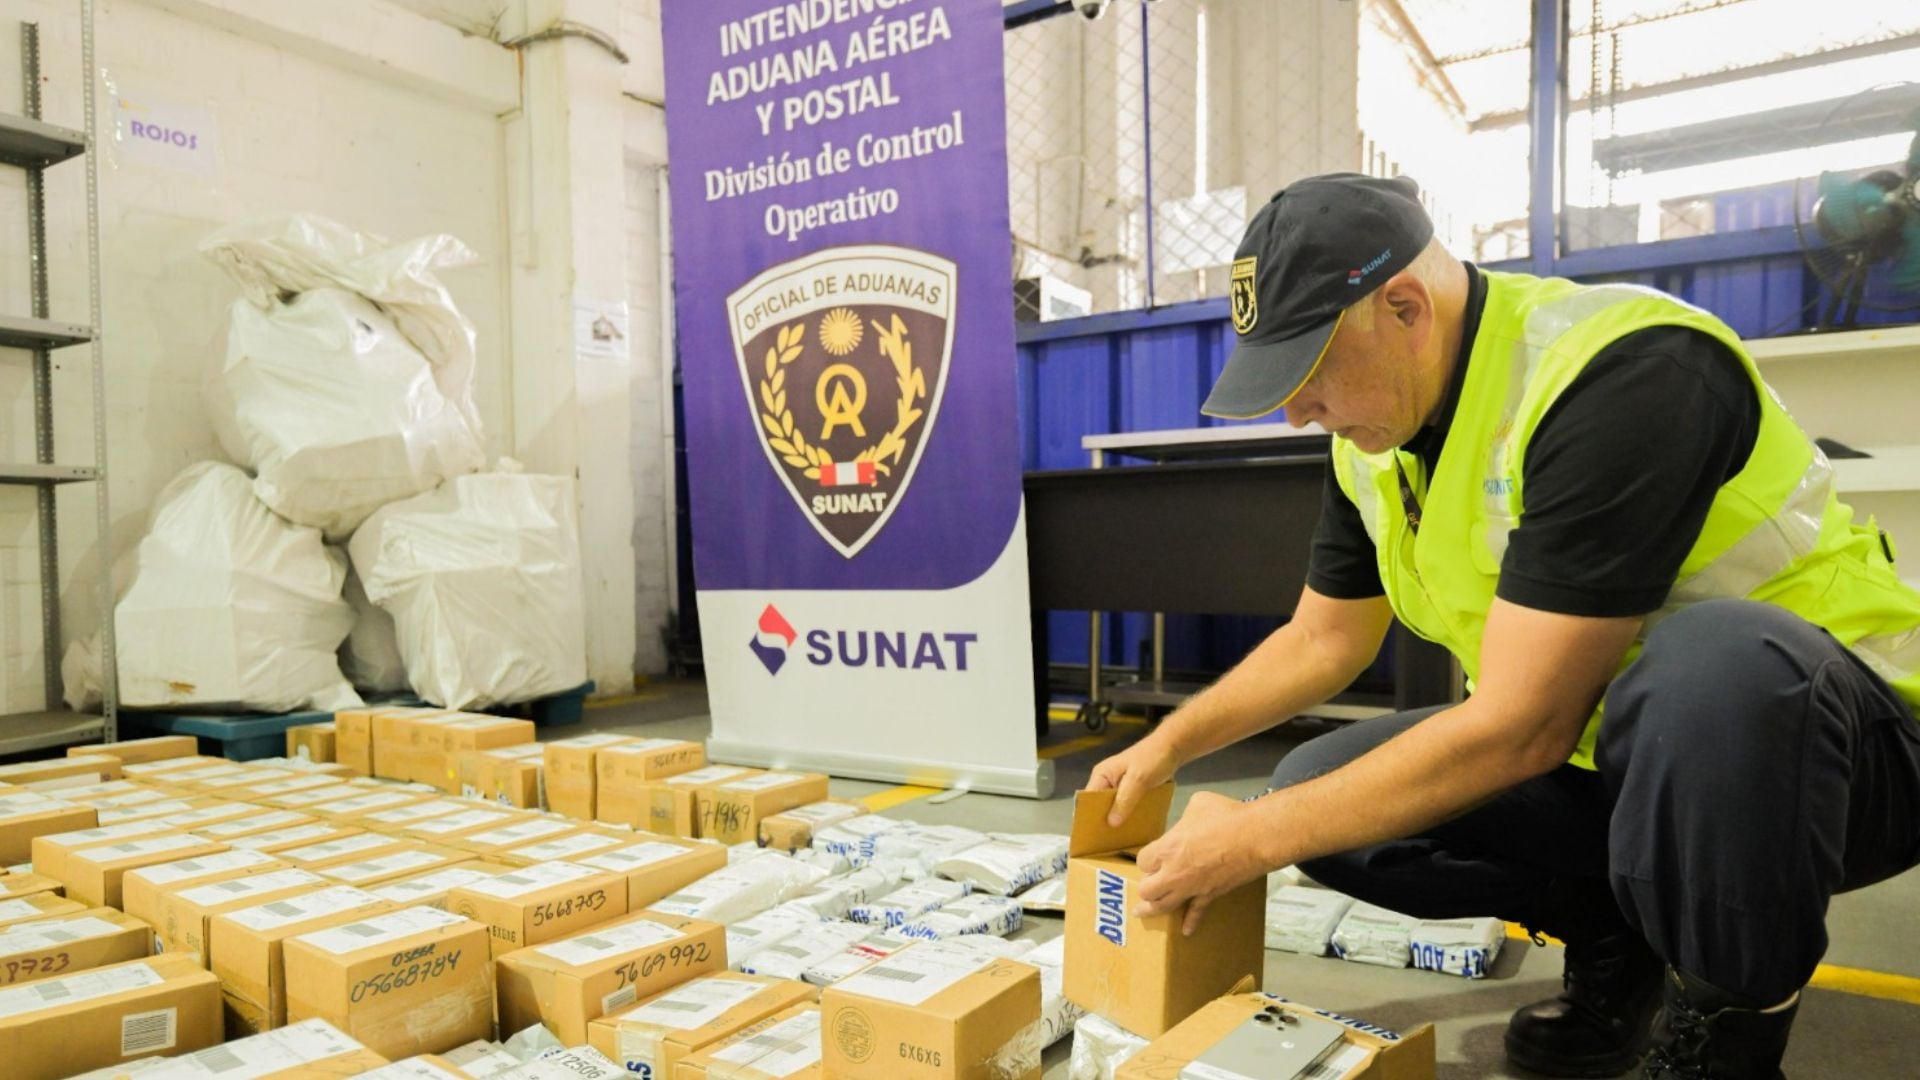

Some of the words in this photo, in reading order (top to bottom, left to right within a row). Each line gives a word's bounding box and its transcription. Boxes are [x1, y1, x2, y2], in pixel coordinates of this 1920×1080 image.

[706, 39, 838, 106] ADUANA
[845, 6, 952, 68] AÉREA
[755, 101, 775, 136] Y
[783, 72, 900, 131] POSTAL
[131, 119, 197, 150] ROJOS
[703, 151, 812, 201] División
[815, 142, 851, 177] de
[856, 110, 964, 168] Control
[764, 186, 899, 242] Operativo
[1361, 249, 1392, 275] SUNAT
[743, 286, 811, 331] OFICIAL
[814, 276, 837, 298] DE
[843, 273, 942, 305] ADUANAS
[811, 492, 887, 515] SUNAT
[806, 629, 978, 671] SUNAT
[0, 952, 70, 984] 8723
[351, 949, 462, 1003] 05668784
[614, 941, 712, 990] 5669992
[900, 1042, 942, 1068] 6X6X6
